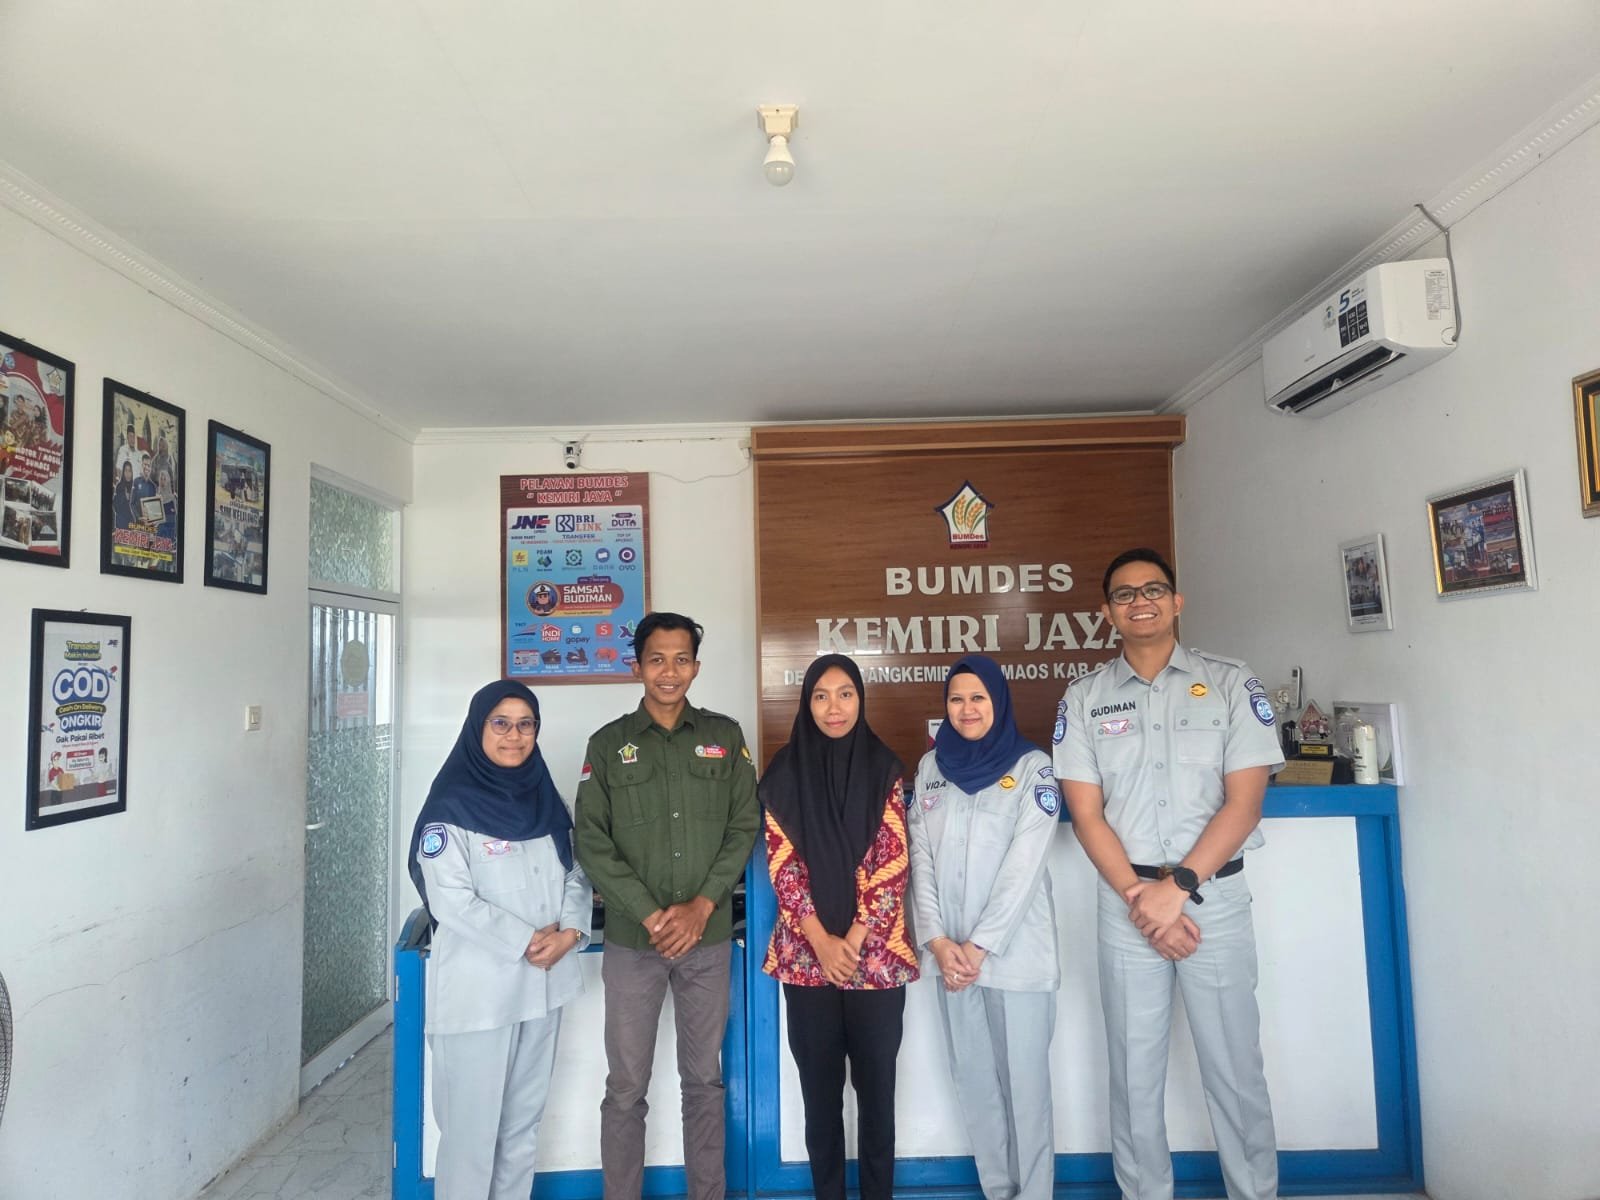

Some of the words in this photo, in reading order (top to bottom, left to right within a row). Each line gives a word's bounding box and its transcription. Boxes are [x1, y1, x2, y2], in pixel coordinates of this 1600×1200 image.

[1338, 289, 1351, 313] 5
[520, 478, 575, 491] PELAYAN
[577, 476, 629, 489] BUMDES
[536, 491, 581, 504] KEMIRI
[583, 490, 614, 503] JAYA
[510, 515, 550, 530] JNE
[576, 514, 595, 523] BRI
[611, 519, 637, 527] DUTA
[576, 523, 602, 532] LINK
[952, 533, 984, 541] BUMDes
[886, 563, 1073, 596] BUMDES
[563, 585, 605, 595] SAMSAT
[563, 594, 612, 604] BUDIMAN
[565, 634, 590, 644] gopay
[815, 614, 1001, 655] KEMIRI
[1024, 612, 1123, 652] JAYA
[53, 667, 110, 702] COD
[1090, 701, 1136, 718] GUDIMAN
[60, 714, 103, 730] ONGKIR
[55, 735, 69, 743] Gak
[70, 733, 88, 742] Pakai
[925, 780, 947, 791] VIQA
